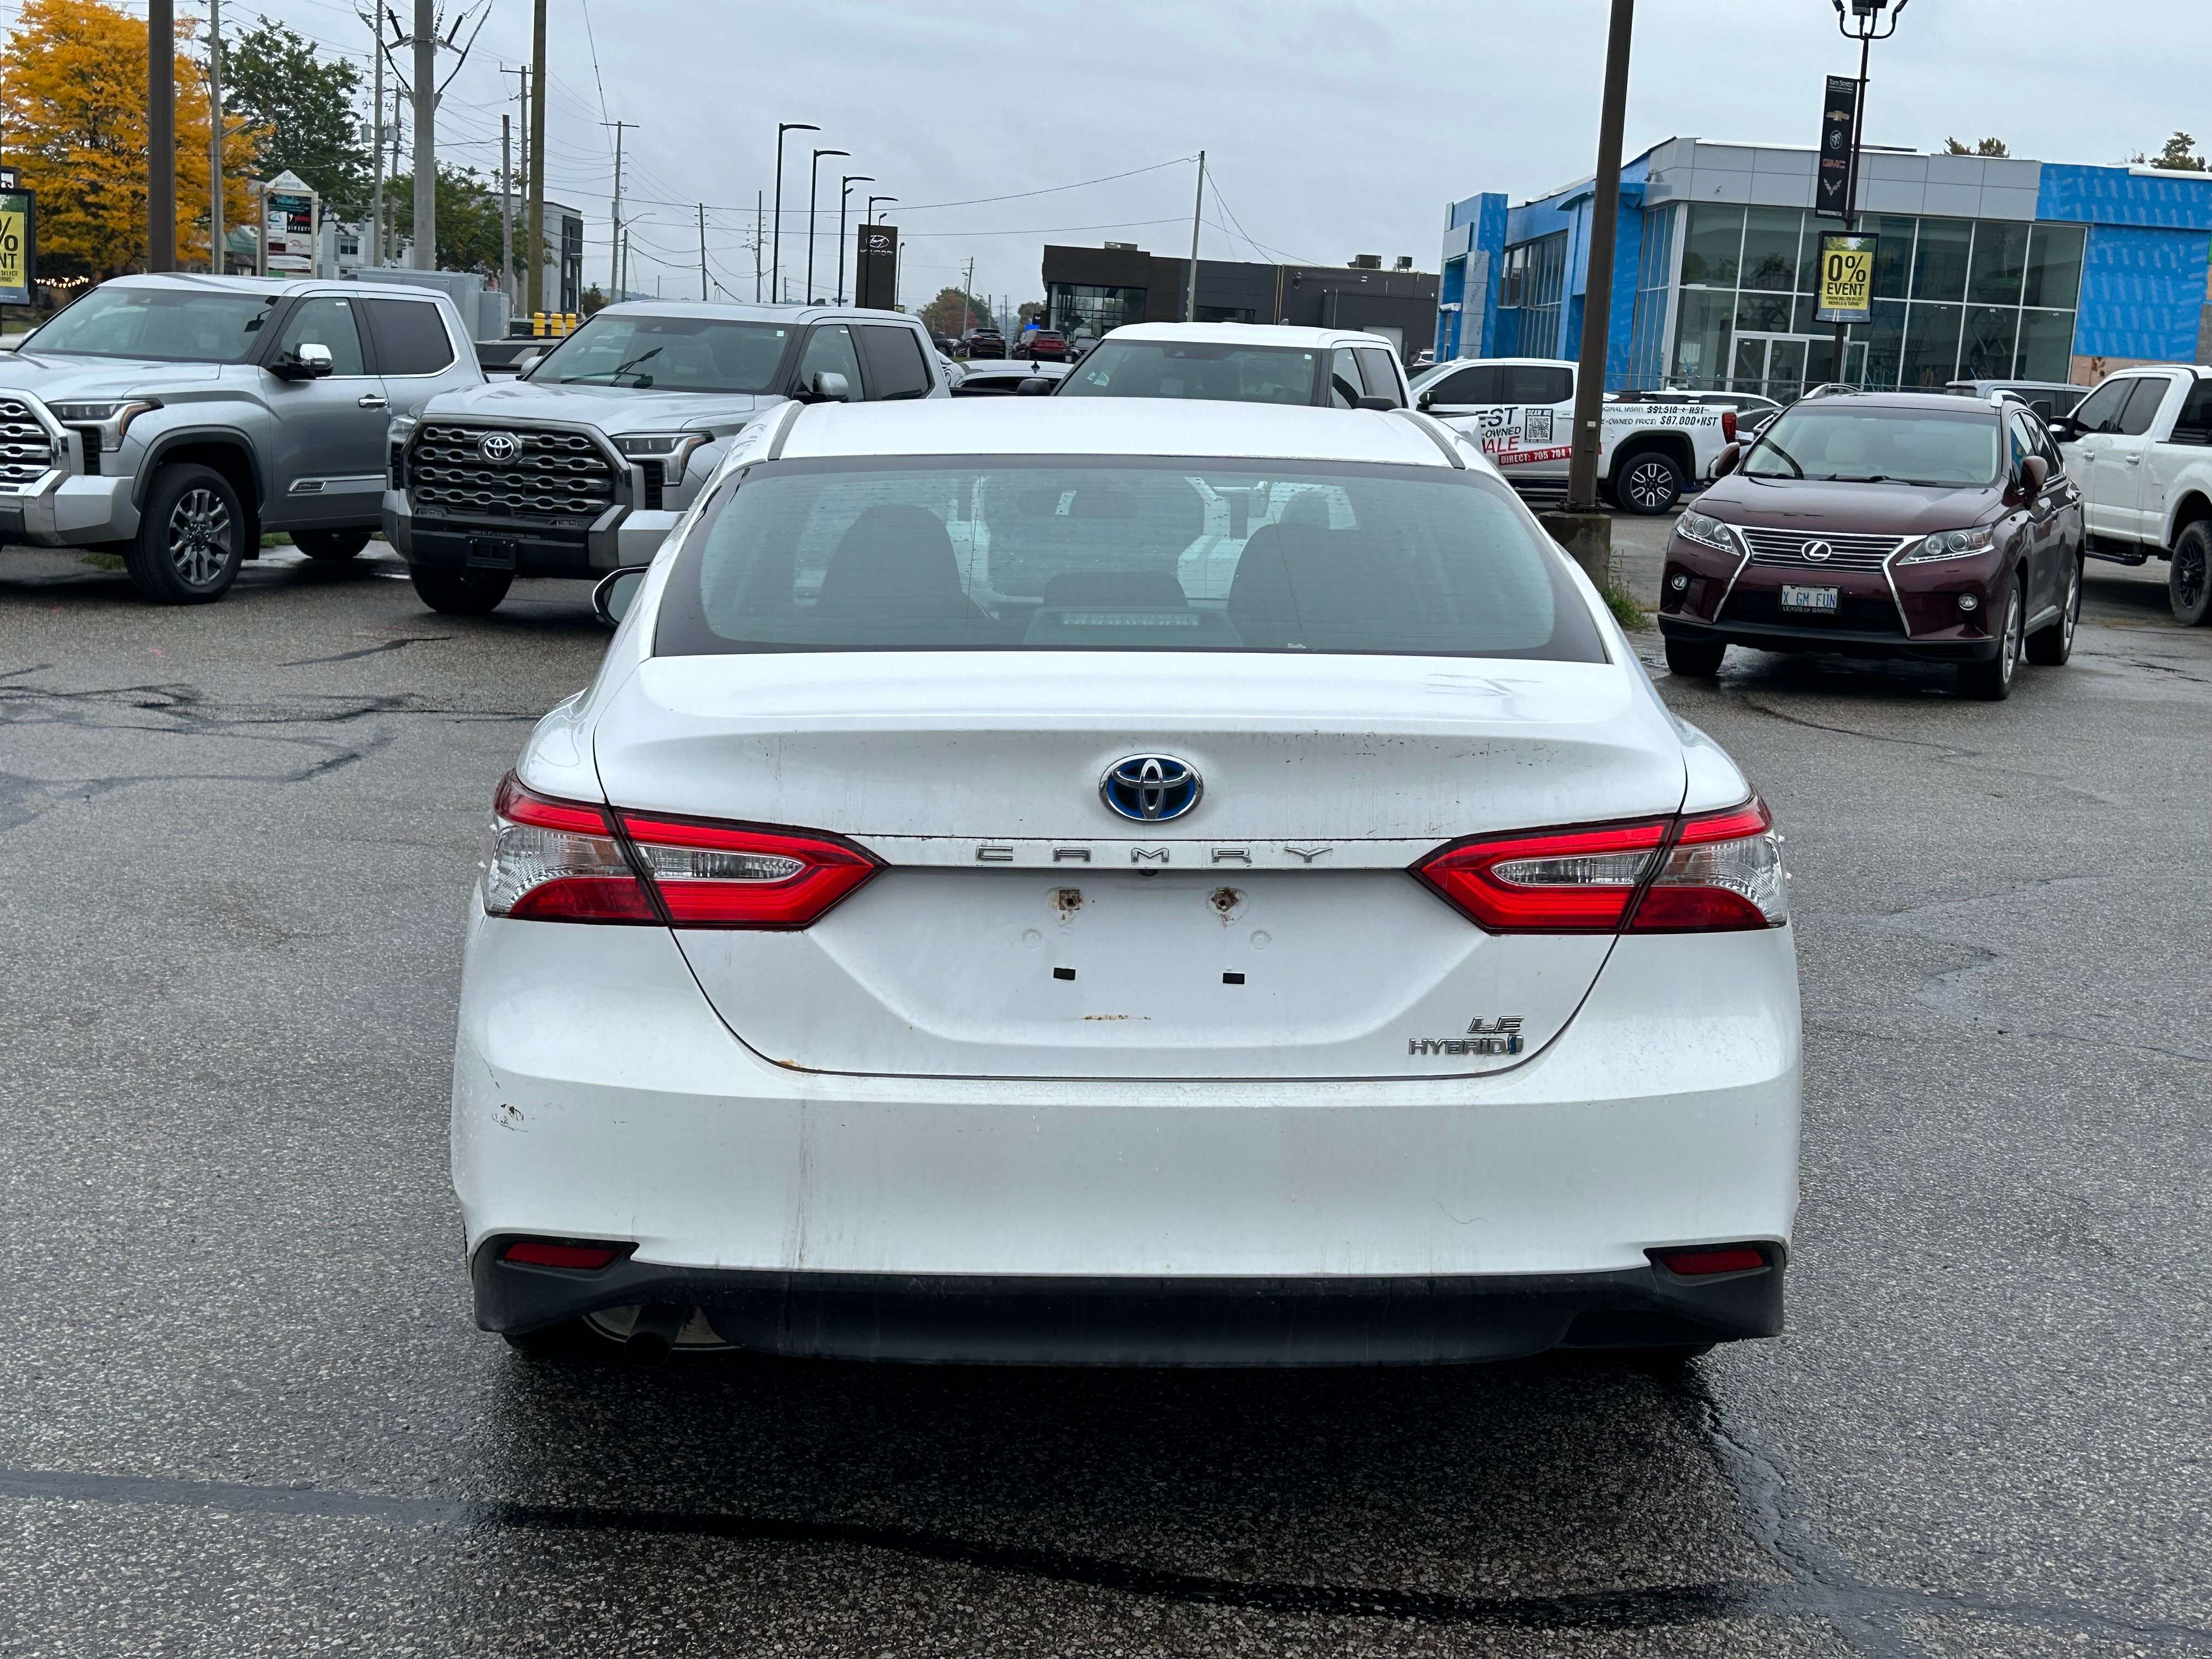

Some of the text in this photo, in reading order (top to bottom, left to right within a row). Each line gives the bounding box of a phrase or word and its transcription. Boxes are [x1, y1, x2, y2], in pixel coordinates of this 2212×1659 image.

[1828, 255, 1866, 283] 0%
[1827, 282, 1865, 296] EVENT
[1783, 591, 1790, 605] X
[1816, 593, 1836, 608] FUN
[975, 845, 1334, 864] CAMRY
[1467, 1016, 1524, 1034] LE
[1409, 1038, 1508, 1055] HYBRID
